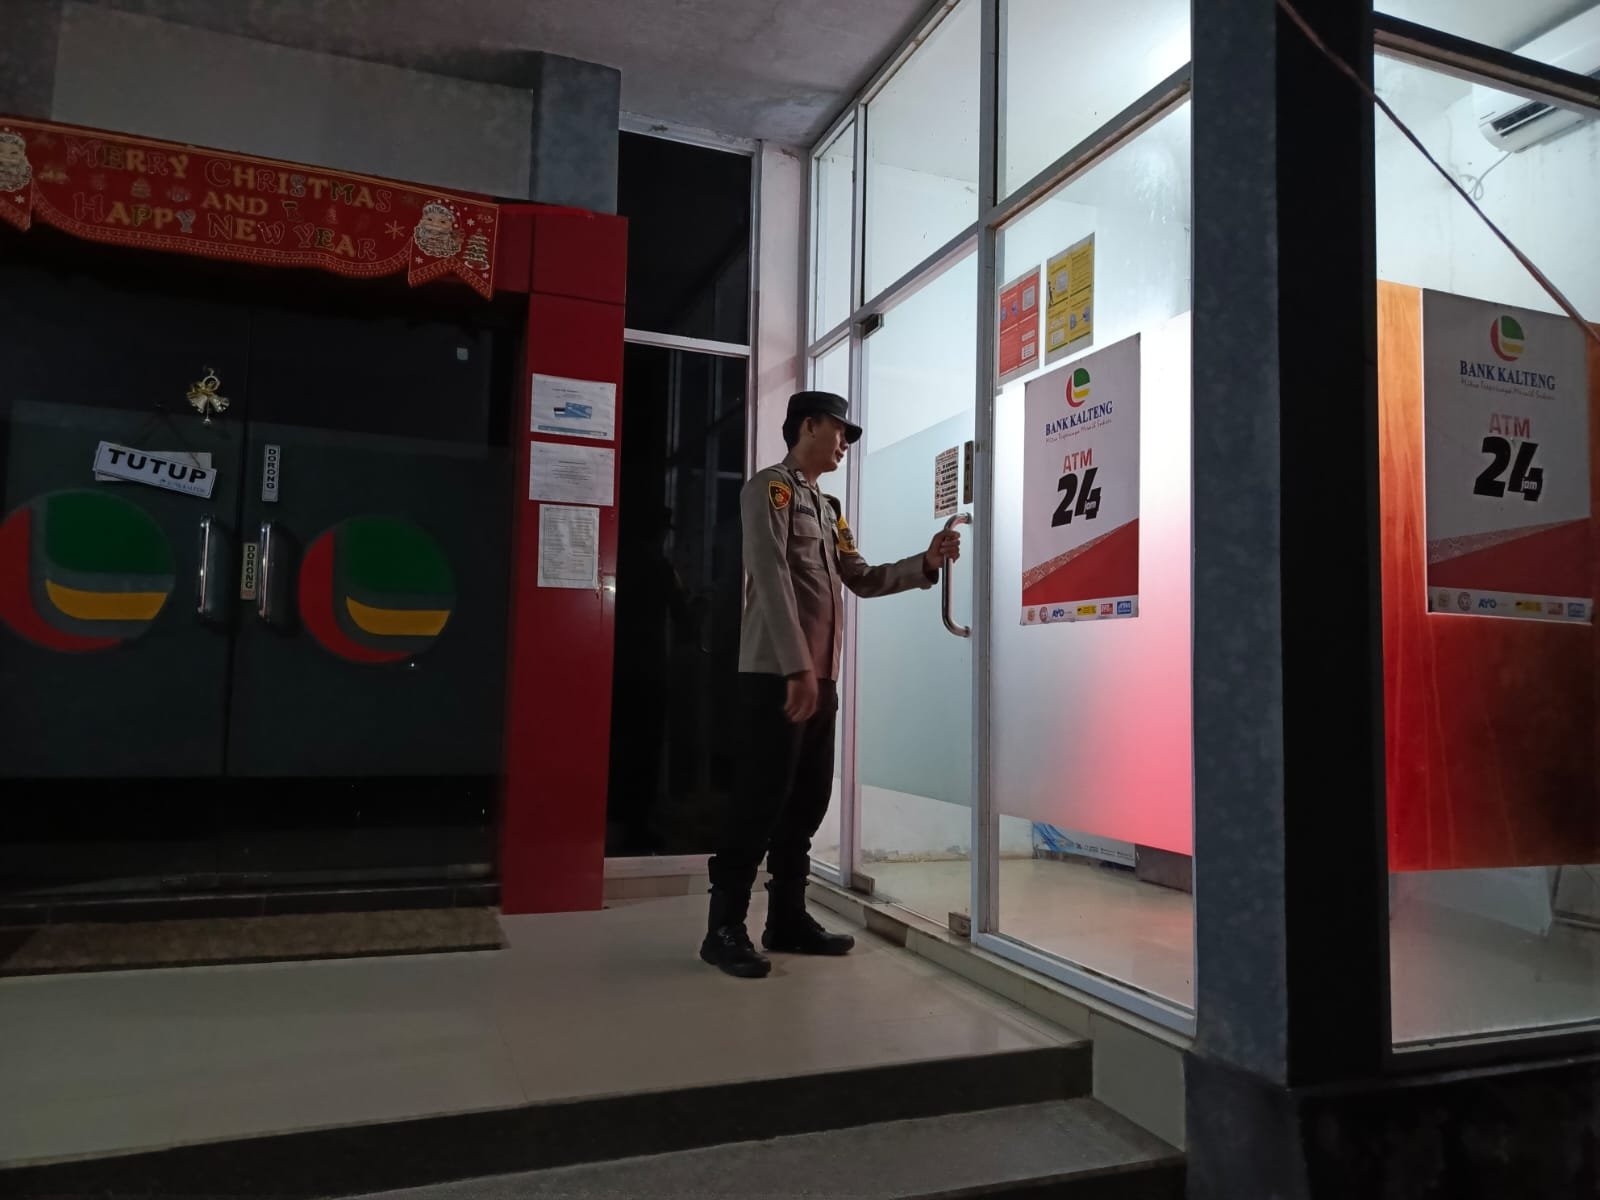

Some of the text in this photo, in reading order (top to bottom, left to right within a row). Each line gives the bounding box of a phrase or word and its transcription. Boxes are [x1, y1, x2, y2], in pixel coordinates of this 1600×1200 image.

[66, 139, 392, 213] MERRY CHRISTMAS
[202, 192, 268, 215] AND
[73, 192, 378, 261] HAPPY NEW YEAR
[1459, 360, 1495, 381] BANK
[1497, 367, 1556, 391] KALTENG
[1045, 418, 1069, 436] BANK
[1070, 400, 1113, 428] KALTENG
[1488, 414, 1531, 438] ATM
[109, 448, 207, 483] TUTUP
[266, 449, 277, 489] DORONG
[1063, 448, 1093, 472] ATM
[1473, 436, 1544, 502] 24
[1051, 467, 1101, 528] 24
[246, 545, 257, 589] DORONG
